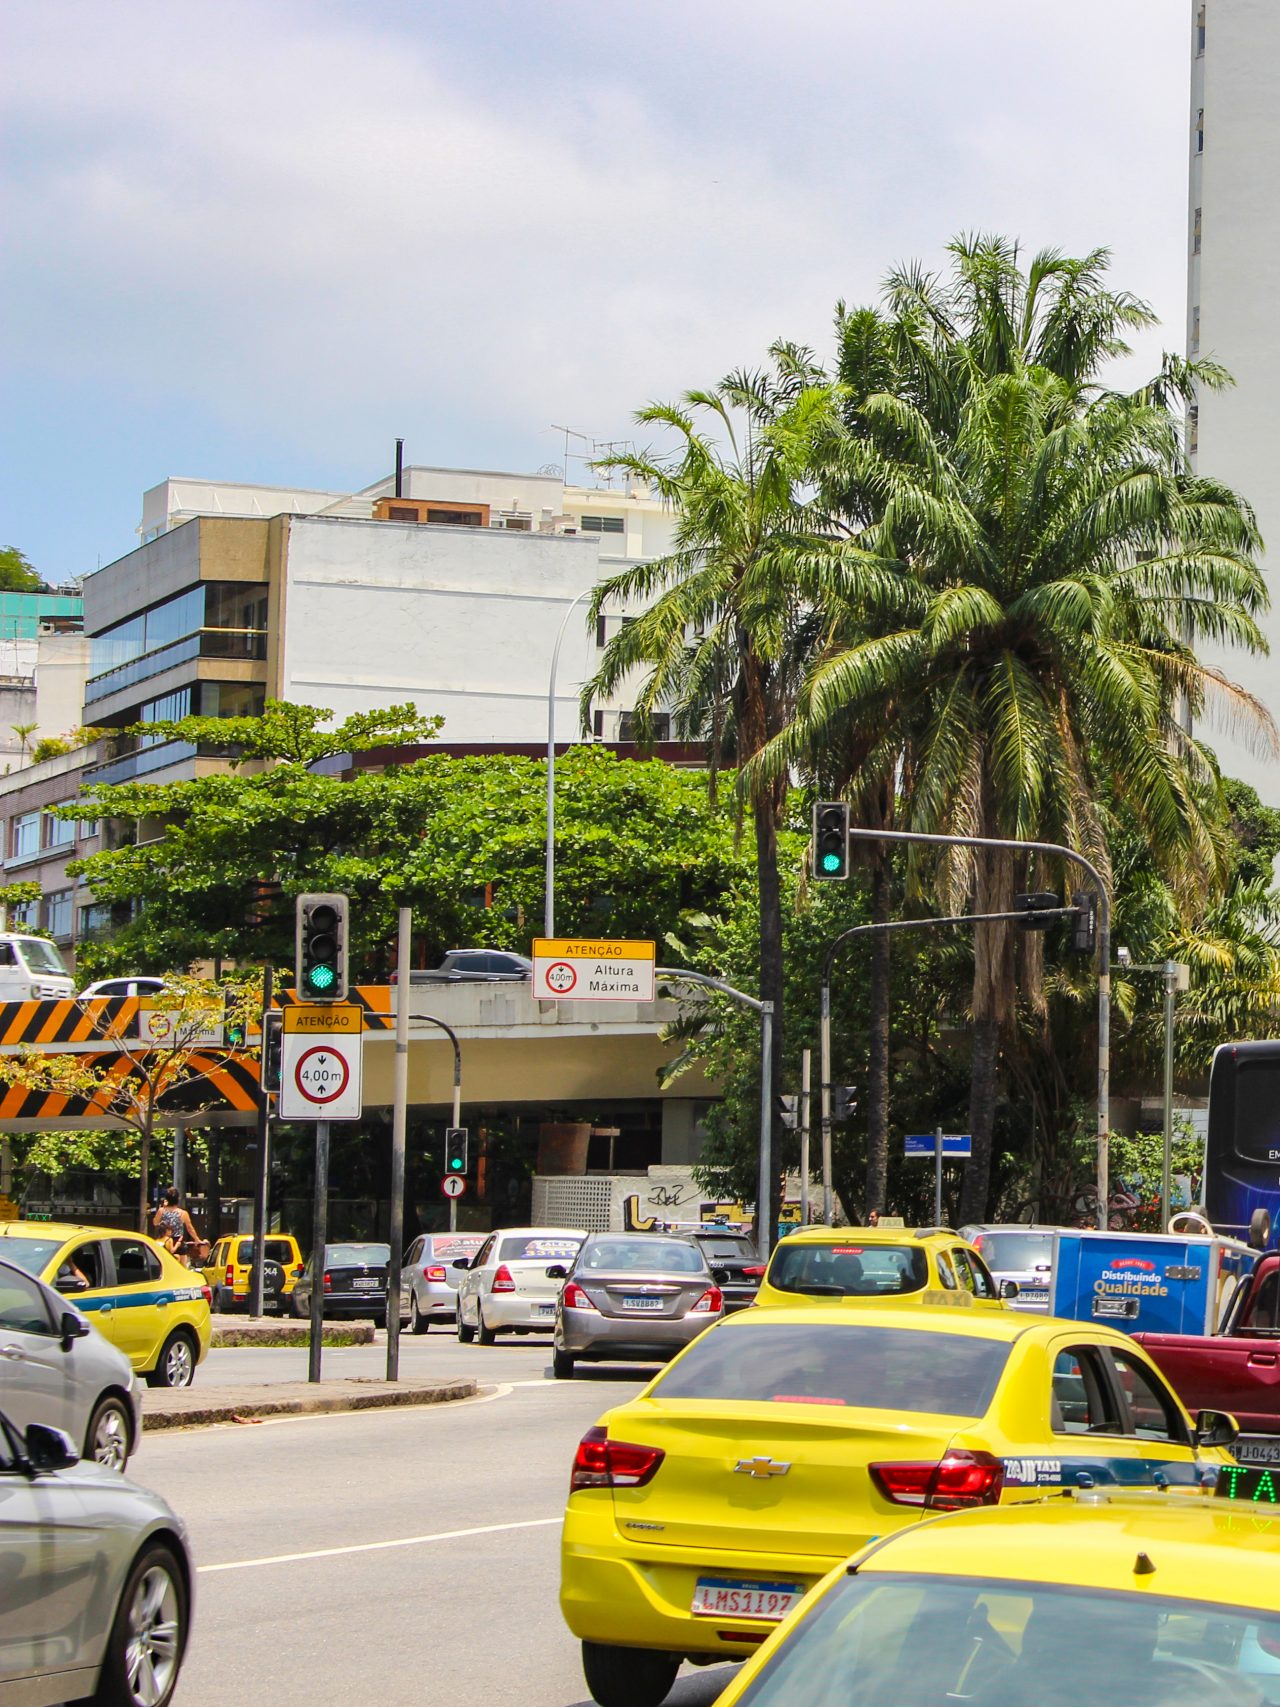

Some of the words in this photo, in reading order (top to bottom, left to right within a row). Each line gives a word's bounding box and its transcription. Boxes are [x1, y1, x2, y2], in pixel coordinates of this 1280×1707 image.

[565, 944, 623, 957] ATENÇÃO
[595, 965, 634, 976] Altura
[589, 980, 639, 992] Máxima
[296, 1015, 349, 1028] ATENÇÃO
[1102, 1270, 1162, 1283] Distribuindo
[1094, 1279, 1168, 1297] Qualidade
